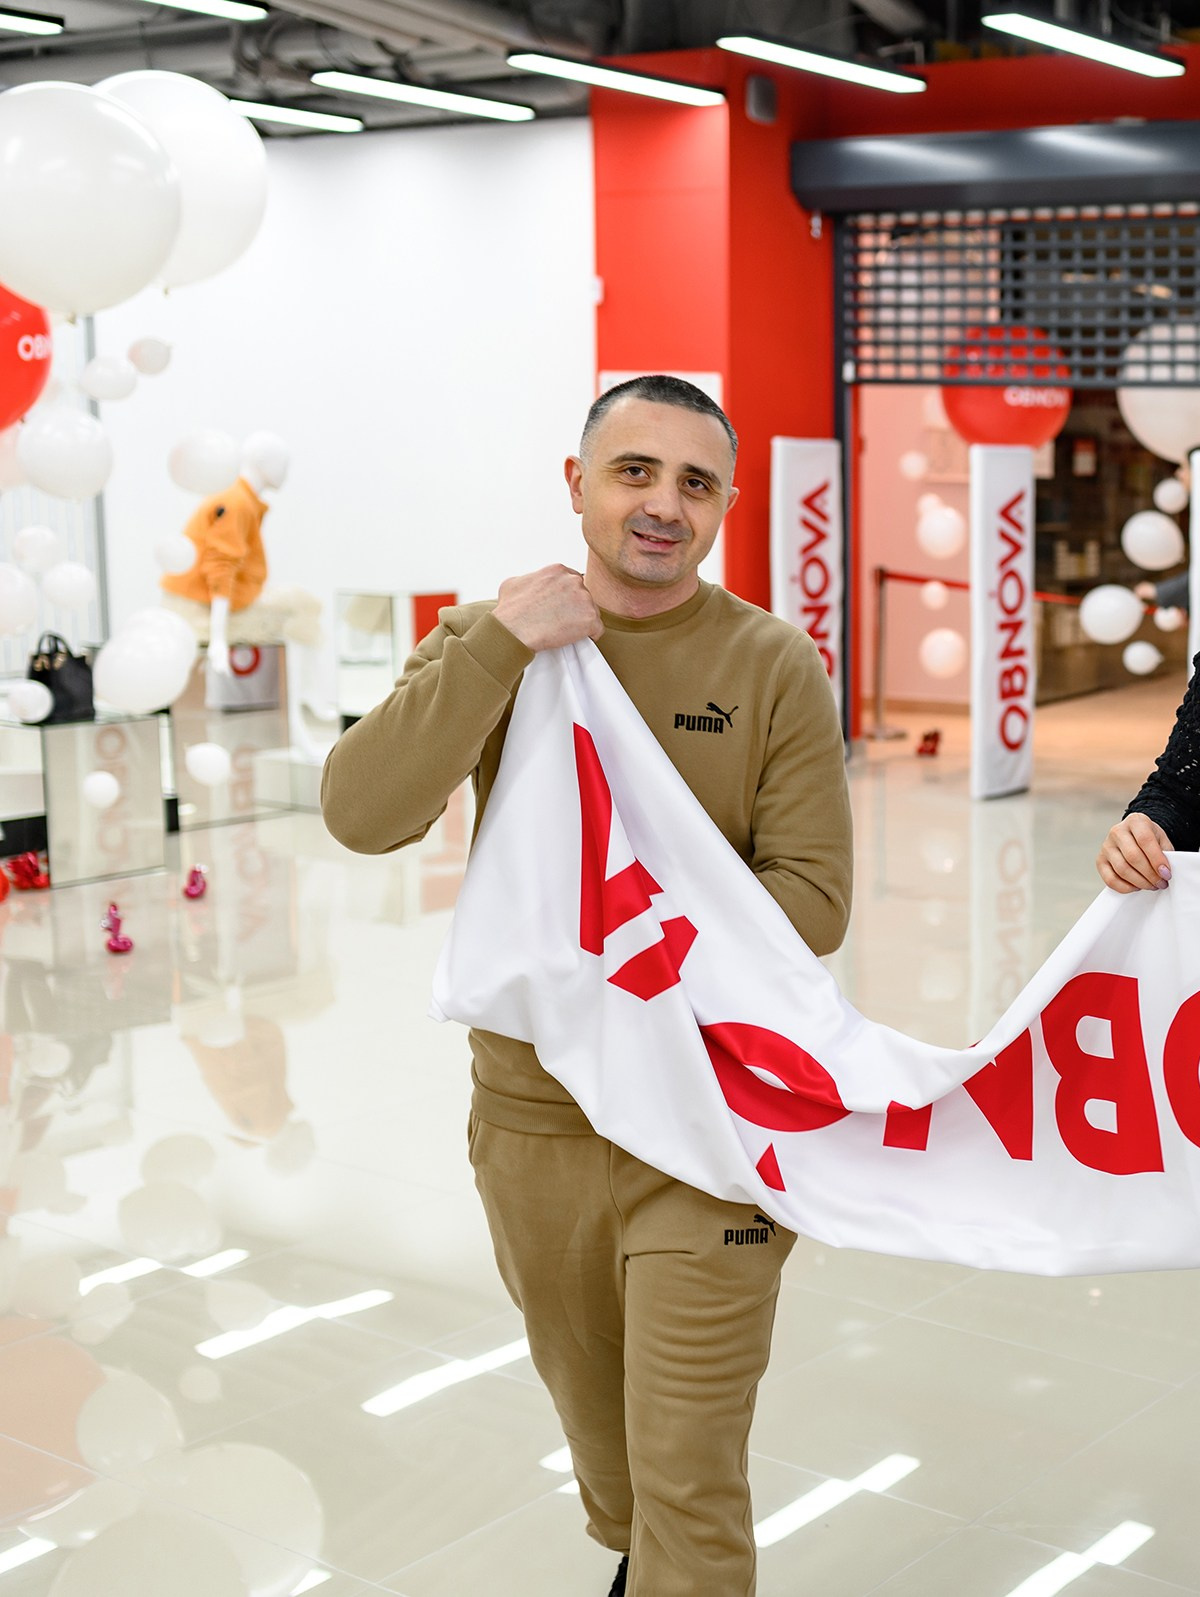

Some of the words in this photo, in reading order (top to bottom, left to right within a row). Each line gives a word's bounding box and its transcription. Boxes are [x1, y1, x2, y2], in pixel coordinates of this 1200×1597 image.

[798, 478, 834, 678] NOVA
[997, 487, 1029, 752] OBNOVA
[674, 713, 724, 734] PUMA
[724, 1228, 769, 1246] PUMA
